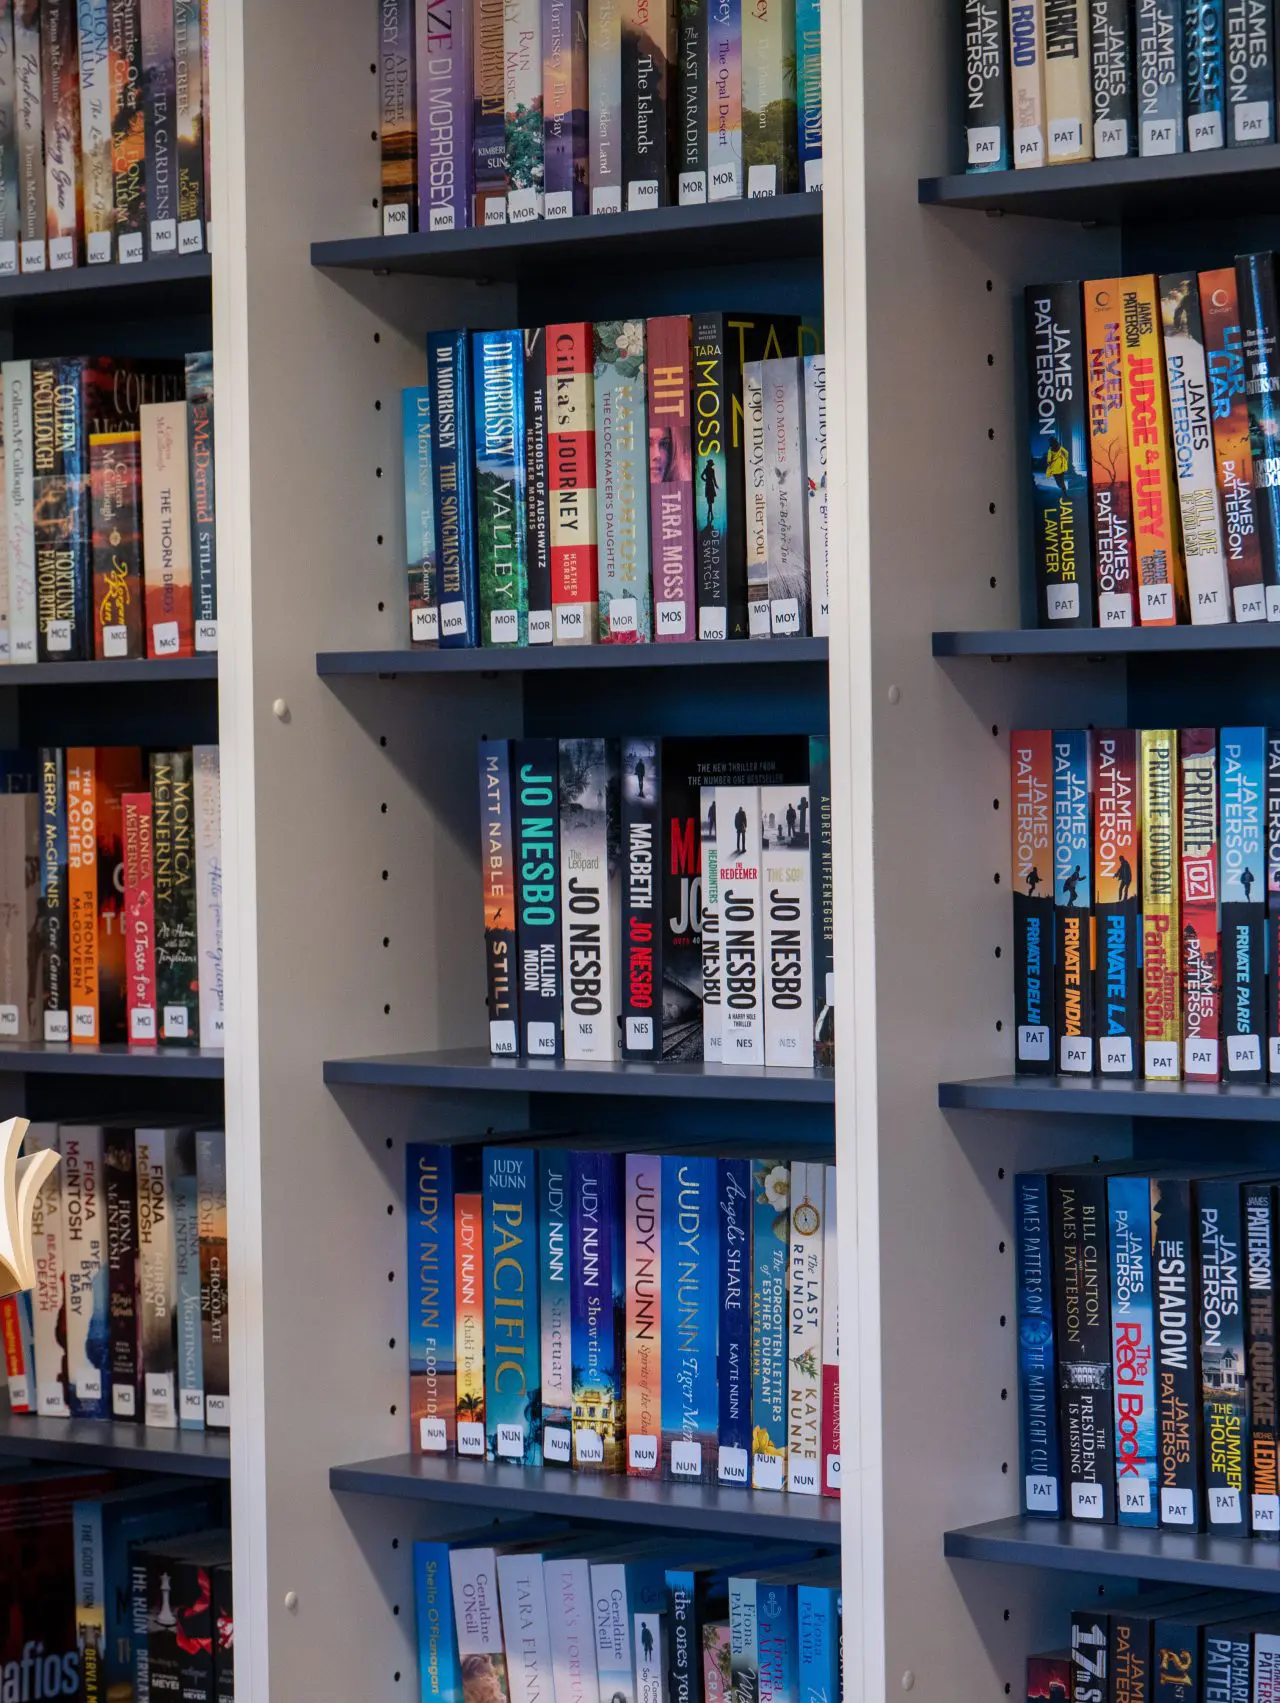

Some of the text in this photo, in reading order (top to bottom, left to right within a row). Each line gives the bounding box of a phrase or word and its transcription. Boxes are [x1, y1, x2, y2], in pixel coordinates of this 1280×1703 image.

[981, 3, 999, 80] JAMES
[1013, 5, 1036, 67] ROAD
[1092, 1, 1111, 123] PATTERSON
[1109, 25, 1126, 97] JAMES
[382, 53, 396, 126] JOURNEY
[550, 112, 565, 139] Bay
[638, 54, 654, 154] The Islands
[153, 90, 169, 220] TEA GARDENS
[428, 58, 453, 209] DI MORRISSEY
[976, 141, 994, 152] PAT
[388, 212, 406, 222] MOR
[694, 345, 721, 357] TARA
[1122, 292, 1140, 349] PATTERSON
[1138, 302, 1152, 335] JAMES
[437, 347, 456, 449] DI MORRISSEY
[653, 366, 685, 418] HIT
[1034, 299, 1055, 436] PATTERSON
[1053, 323, 1073, 403] JAMES
[1089, 349, 1109, 437] NEVER
[1103, 322, 1123, 412] NEVER
[1223, 326, 1246, 398] LIAR
[53, 385, 77, 452] COLLEEN
[483, 341, 514, 456] DI MORRISSEY
[696, 360, 720, 457] MOSS
[774, 385, 786, 463] JOJO MOYES
[1128, 354, 1158, 447] JUDGE
[192, 419, 214, 524] McDermid
[533, 388, 547, 569] THE TATTOOIST OF AUSCHWITZ
[1134, 464, 1165, 539] JURY
[160, 488, 173, 569] THE THORN
[440, 462, 460, 593] THE SONGMASTER
[492, 481, 513, 599] VALLEY
[661, 490, 684, 599] TARA MOSS
[753, 494, 767, 556] after you
[1043, 509, 1059, 574] LAWYER
[1059, 497, 1076, 583] JAILHOUSE
[1194, 489, 1218, 557] KILL ME
[199, 532, 212, 620] STILL LIFE
[703, 539, 711, 590] SWITCH
[712, 570, 720, 599] MAN
[443, 618, 462, 627] MOR
[661, 611, 682, 622] MOS
[775, 613, 796, 623] MOY
[1055, 601, 1073, 610] PAT
[43, 761, 59, 909] KERRY McGINNIS
[68, 767, 80, 869] TEACHER
[81, 770, 94, 866] THE GOOD
[138, 815, 152, 881] MONICA
[173, 781, 190, 886] MONICA
[486, 756, 504, 897] MATT NABLE
[520, 764, 555, 925] JO NESBO
[1017, 749, 1034, 878] PATTERSON
[1033, 777, 1048, 849] JAMES
[1072, 774, 1086, 850] JAMES
[568, 855, 599, 872] Leopard
[720, 868, 758, 880] REDEEMER
[1188, 866, 1207, 895] OZ
[83, 891, 94, 996] PETRONELLA
[492, 940, 510, 1017] STILL
[524, 950, 539, 991] MOON
[540, 944, 556, 997] KILLING
[1025, 917, 1041, 1025] PRIVATE DELHI
[1064, 917, 1081, 1036] PRIVATE INDIA
[1145, 914, 1170, 1037] Patterson
[1163, 967, 1175, 1021] James
[495, 1042, 512, 1051] NAB
[539, 1038, 555, 1047] NES
[1025, 1031, 1045, 1043] PAT
[83, 1161, 96, 1221] FIONA
[150, 1164, 164, 1225] FIONA
[36, 1258, 49, 1312] DEATH
[46, 1234, 59, 1313] BEAUTIFUL
[80, 1261, 92, 1293] BYE
[89, 1240, 101, 1269] BYE
[461, 1210, 475, 1304] JUDY NUNN
[1022, 1185, 1043, 1314] JAMES PATTERSON
[1059, 1188, 1080, 1343] JAMES PATTERSON
[1082, 1205, 1099, 1327] BILL CLINTON
[70, 1274, 82, 1316] BABY
[201, 1286, 210, 1312] TIN
[210, 1256, 223, 1344] CHOCOLATE
[492, 1200, 526, 1396] PACIFIC
[792, 1244, 804, 1335] REUNION
[1158, 1258, 1188, 1370] SHADOW
[771, 1250, 783, 1422] The FORGOTTEN LETTERS
[1141, 1344, 1152, 1377] The
[428, 1429, 445, 1438] NUN
[1028, 1375, 1047, 1445] MIDNIGHT
[1115, 1322, 1147, 1477] Red Book
[1068, 1403, 1081, 1474] IS MISSING
[1081, 1395, 1096, 1484] PRESIDENT
[1096, 1428, 1106, 1450] THE
[1210, 1415, 1226, 1473] HOUSE
[1033, 1484, 1052, 1496] PAT
[133, 1598, 147, 1634] RUIN
[476, 1573, 492, 1643] Geraldine
[516, 1576, 534, 1630] TARA
[674, 1591, 691, 1668] the ones
[731, 1592, 744, 1655] PALMER
[743, 1603, 756, 1647] Fiona
